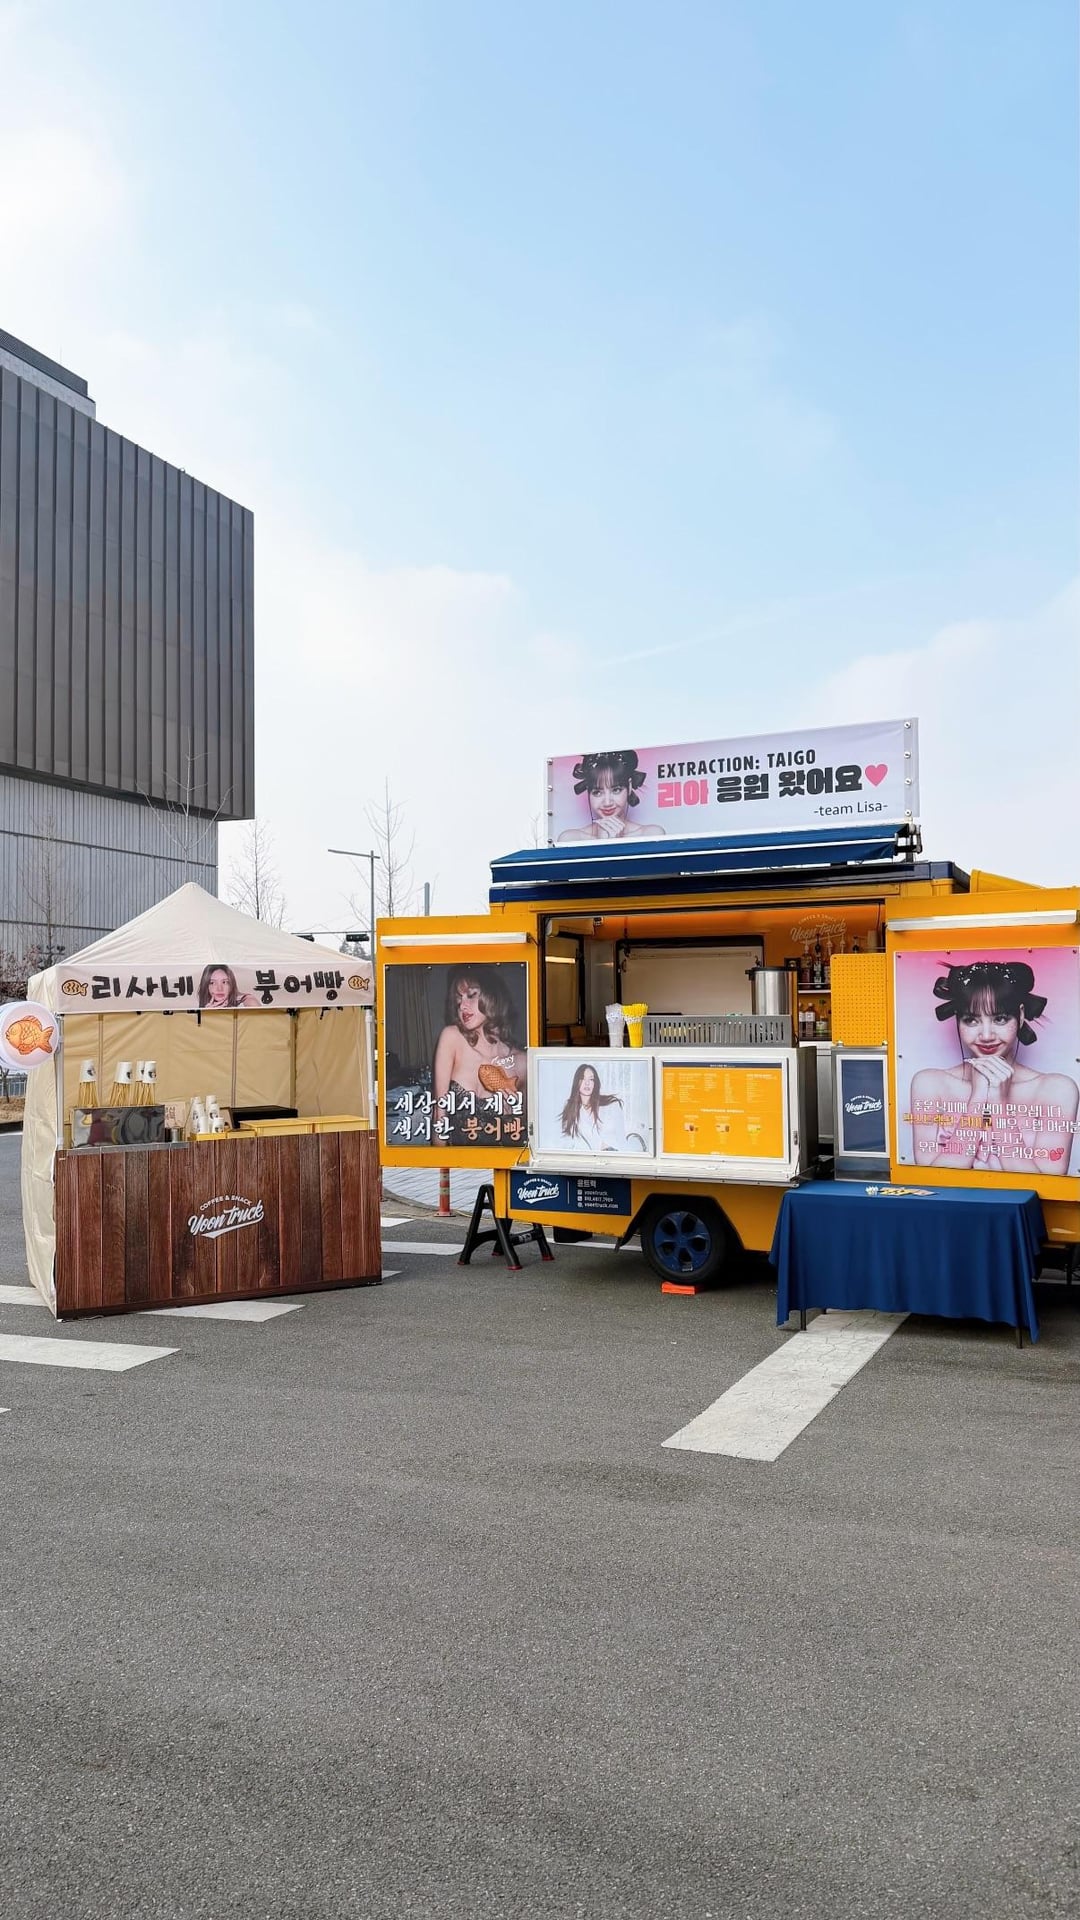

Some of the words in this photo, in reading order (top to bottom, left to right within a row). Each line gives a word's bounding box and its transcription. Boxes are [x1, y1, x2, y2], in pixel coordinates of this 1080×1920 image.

[658, 756, 760, 778] EXTRACTION:
[767, 749, 816, 768] TAIGO
[657, 779, 709, 808] 리아
[717, 773, 769, 803] 응원
[778, 765, 863, 798] 왔어요
[814, 804, 853, 816] -team
[857, 801, 888, 813] Lisa-
[92, 975, 194, 1000] 리사네
[254, 969, 345, 1004] 붕어빵
[394, 1091, 476, 1115] 세상에서
[484, 1091, 523, 1115] 제일
[1006, 1104, 1065, 1119] 많으십니다.
[393, 1117, 454, 1140] 섹시한
[461, 1117, 525, 1141] 붕어빵
[200, 1195, 224, 1211] COFFEE
[231, 1195, 252, 1206] SNACK
[188, 1214, 226, 1236] Yoon
